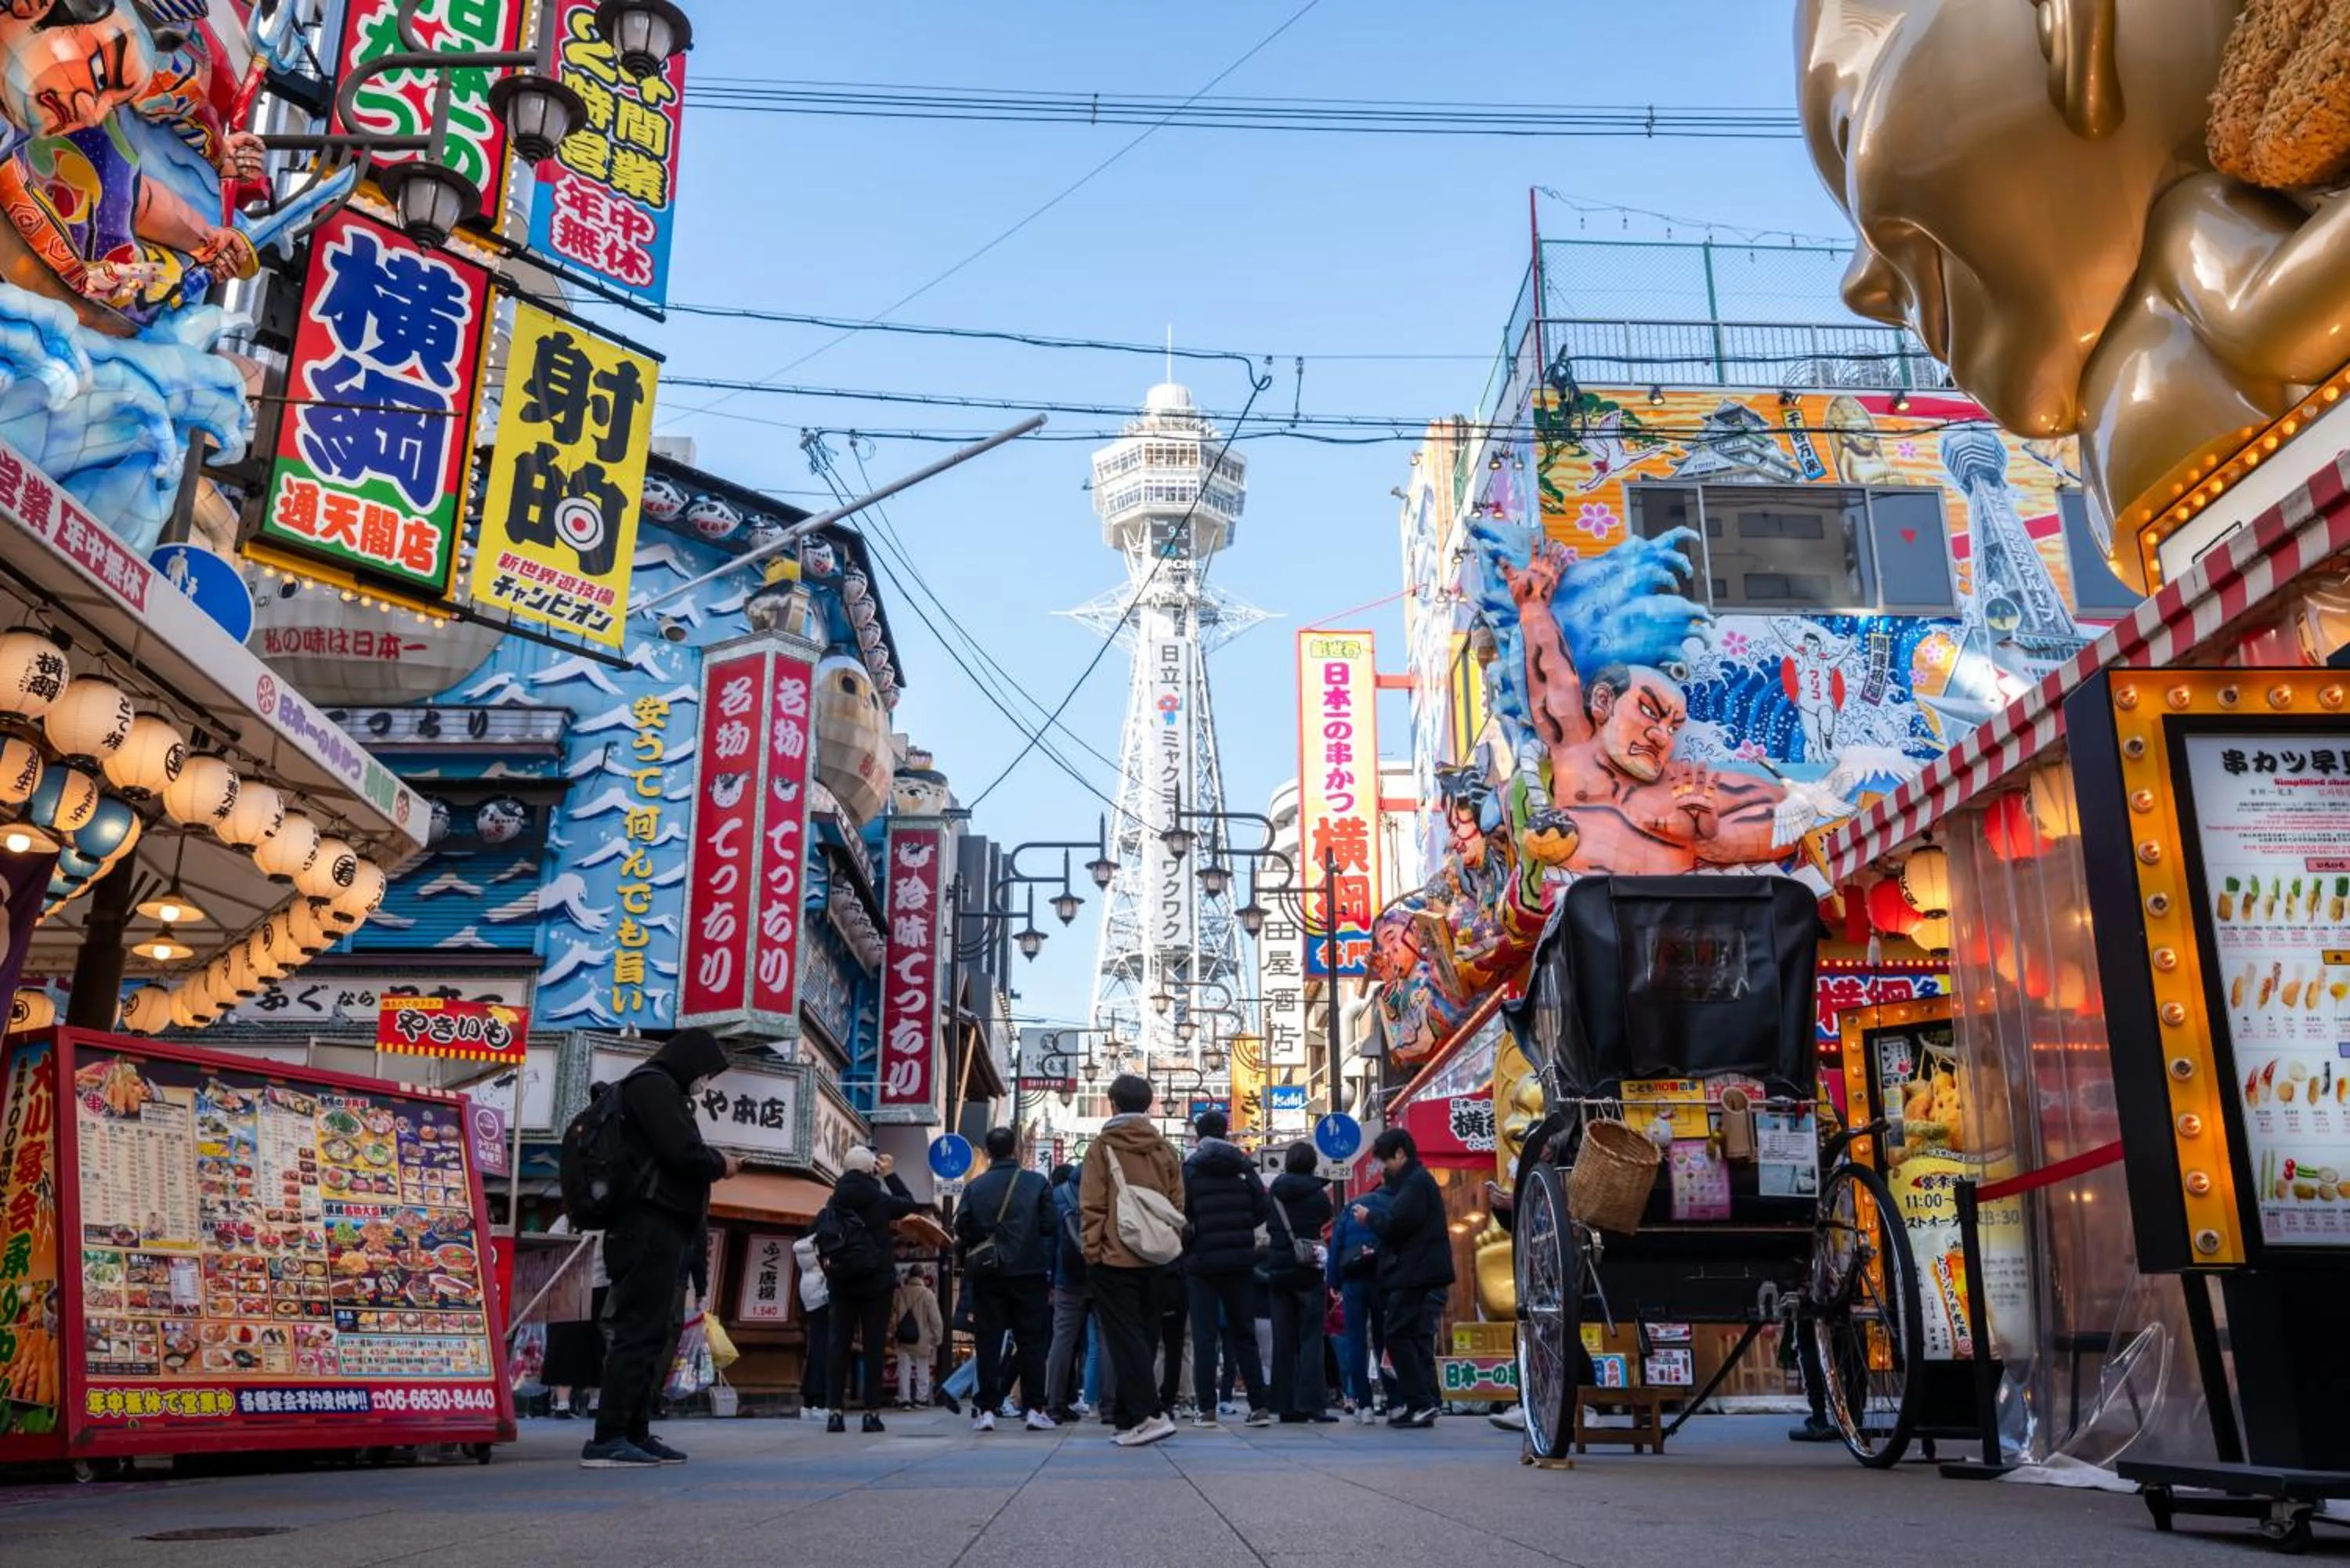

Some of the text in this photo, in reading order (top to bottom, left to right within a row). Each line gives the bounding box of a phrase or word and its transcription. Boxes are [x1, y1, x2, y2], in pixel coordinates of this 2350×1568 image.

[300, 227, 469, 511] 横綱
[504, 331, 644, 576] 射的
[62, 511, 143, 602] 年中無休
[275, 477, 438, 573] 通天閣店
[491, 575, 615, 632] チャンピオン
[498, 551, 616, 609] 新世界遊技場
[264, 629, 428, 660] 私の味は日本一
[714, 674, 753, 761] 名物
[773, 674, 808, 761] 名物
[1322, 663, 1356, 813] 日本一の串かつ
[610, 694, 672, 1016] 安うて何んでも旨い
[1162, 859, 1181, 940] ワクワク
[1312, 816, 1372, 931] 横綱
[396, 1008, 512, 1049] やきいも
